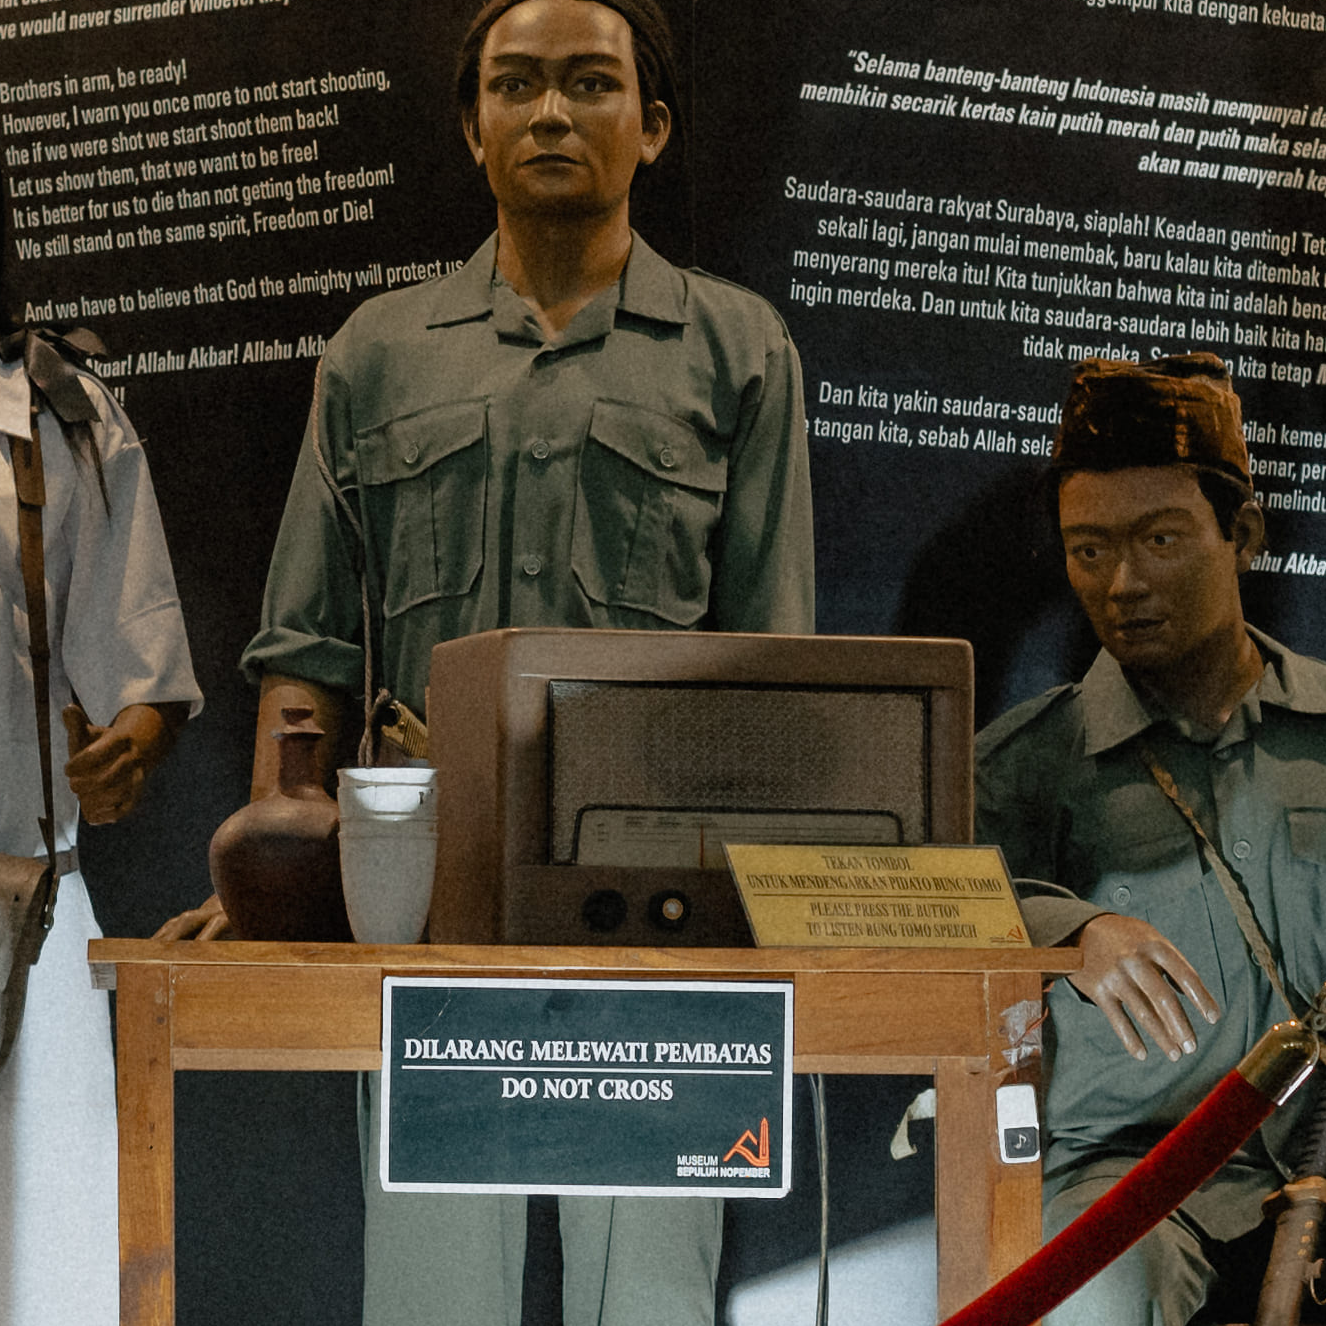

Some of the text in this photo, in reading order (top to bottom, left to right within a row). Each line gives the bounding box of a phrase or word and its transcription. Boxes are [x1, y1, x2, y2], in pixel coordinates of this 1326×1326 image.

[19, 9, 67, 38] would
[69, 9, 112, 31] never
[64, 73, 79, 95] in
[82, 74, 115, 93] arm,
[117, 66, 136, 89] be
[139, 58, 187, 86] ready!
[1137, 150, 1181, 175] akan
[1182, 160, 1221, 179] mau
[1221, 165, 1305, 190] menyerah
[784, 175, 934, 214] Saudara-saudara
[938, 194, 993, 223] rakyat
[995, 199, 1079, 233] Surabaya,
[1083, 209, 1150, 238] siaplah!
[1154, 216, 1226, 246] Keadaan
[1230, 228, 1297, 257] genting!
[15, 198, 374, 261] We still stand on the same spirit, Freedom or Die!
[820, 854, 915, 871] TEKAN TOMBOL
[745, 873, 1002, 893] UNTUK MENDENGARKAN PIDATO BUNG TOMO
[809, 901, 960, 919] PLEASE PRESS THE BUTTON
[804, 921, 978, 939] TO LISTEN BUNG TOMO SPEECH
[403, 1038, 772, 1065] DILARANG MELEWATI PEMBATAS
[501, 1077, 674, 1101] DO NOT CROSS
[677, 1154, 719, 1166] MUSEUM
[676, 1166, 771, 1179] SEPULUH NOPEMBER
